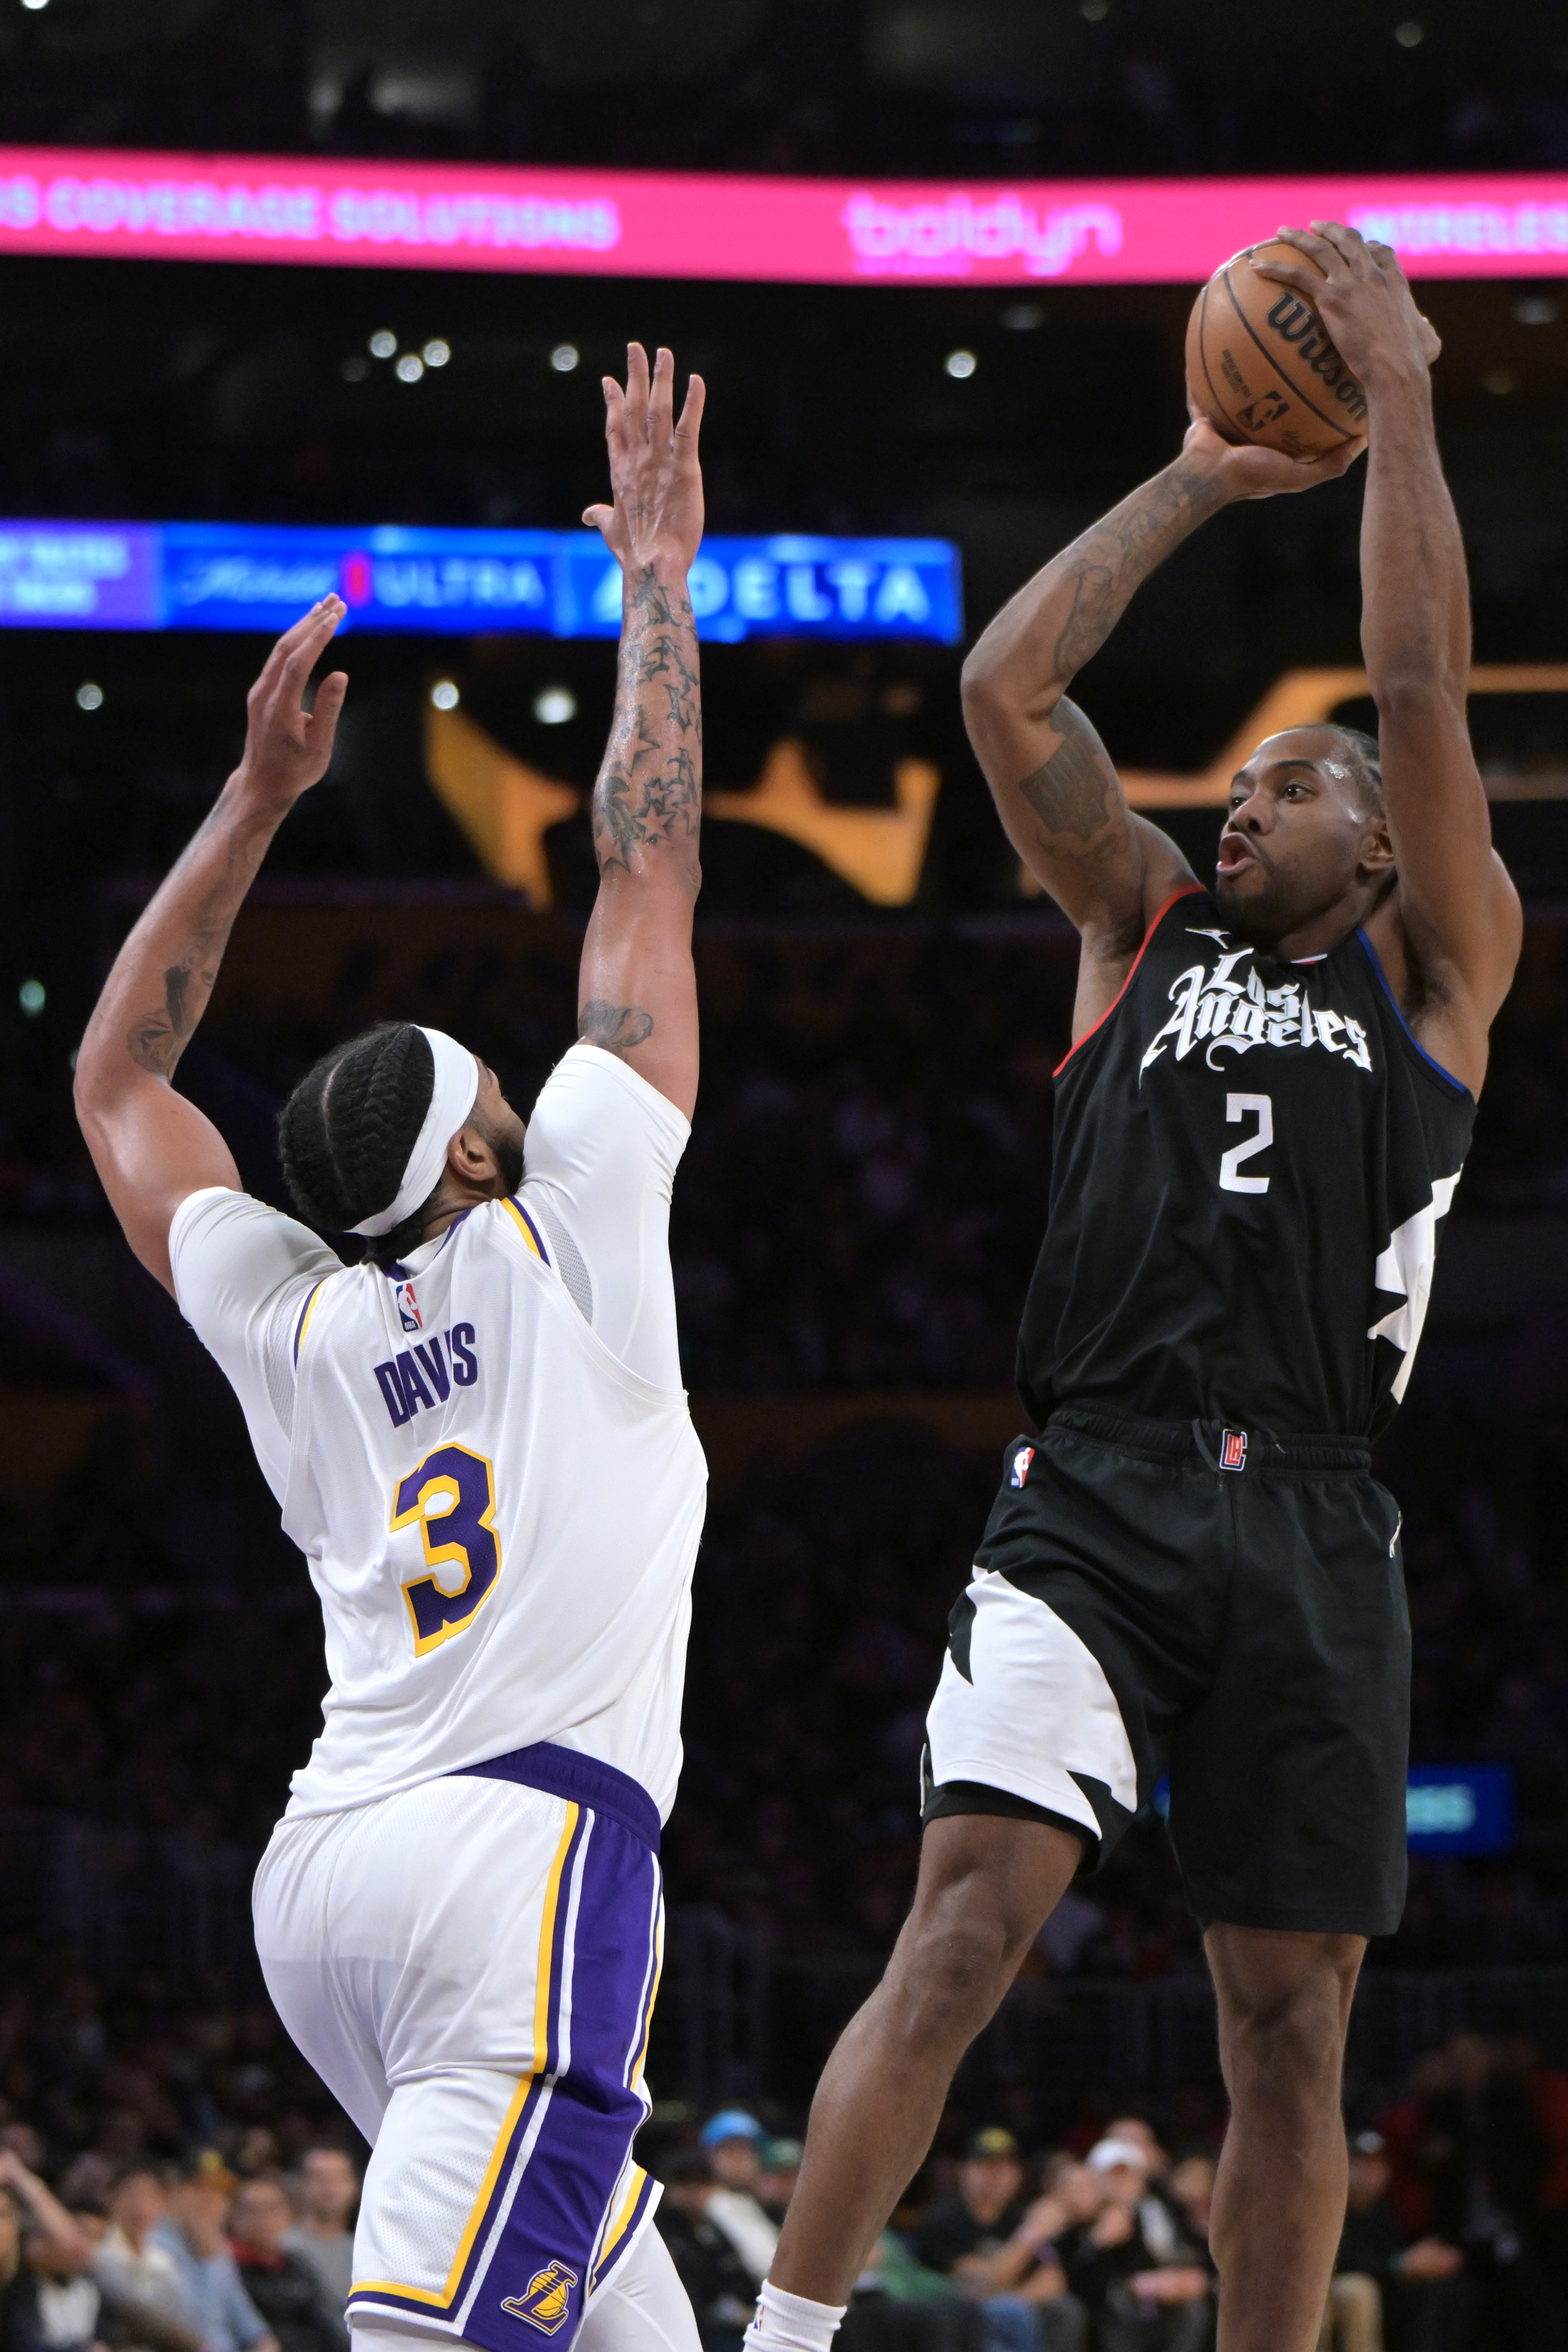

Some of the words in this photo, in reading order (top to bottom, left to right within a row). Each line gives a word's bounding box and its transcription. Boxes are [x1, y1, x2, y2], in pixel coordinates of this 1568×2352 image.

[0, 175, 40, 230] S
[46, 176, 322, 242] COVERAGE
[327, 187, 620, 252] SOLUTIONS
[374, 558, 545, 610] ULTRA
[688, 559, 932, 623] DELTA
[1200, 948, 1300, 1022] Los
[1139, 965, 1372, 1089] Angeles
[1220, 1093, 1273, 1194] 2
[404, 1321, 416, 1330] NBA
[390, 1442, 502, 1658] 3
